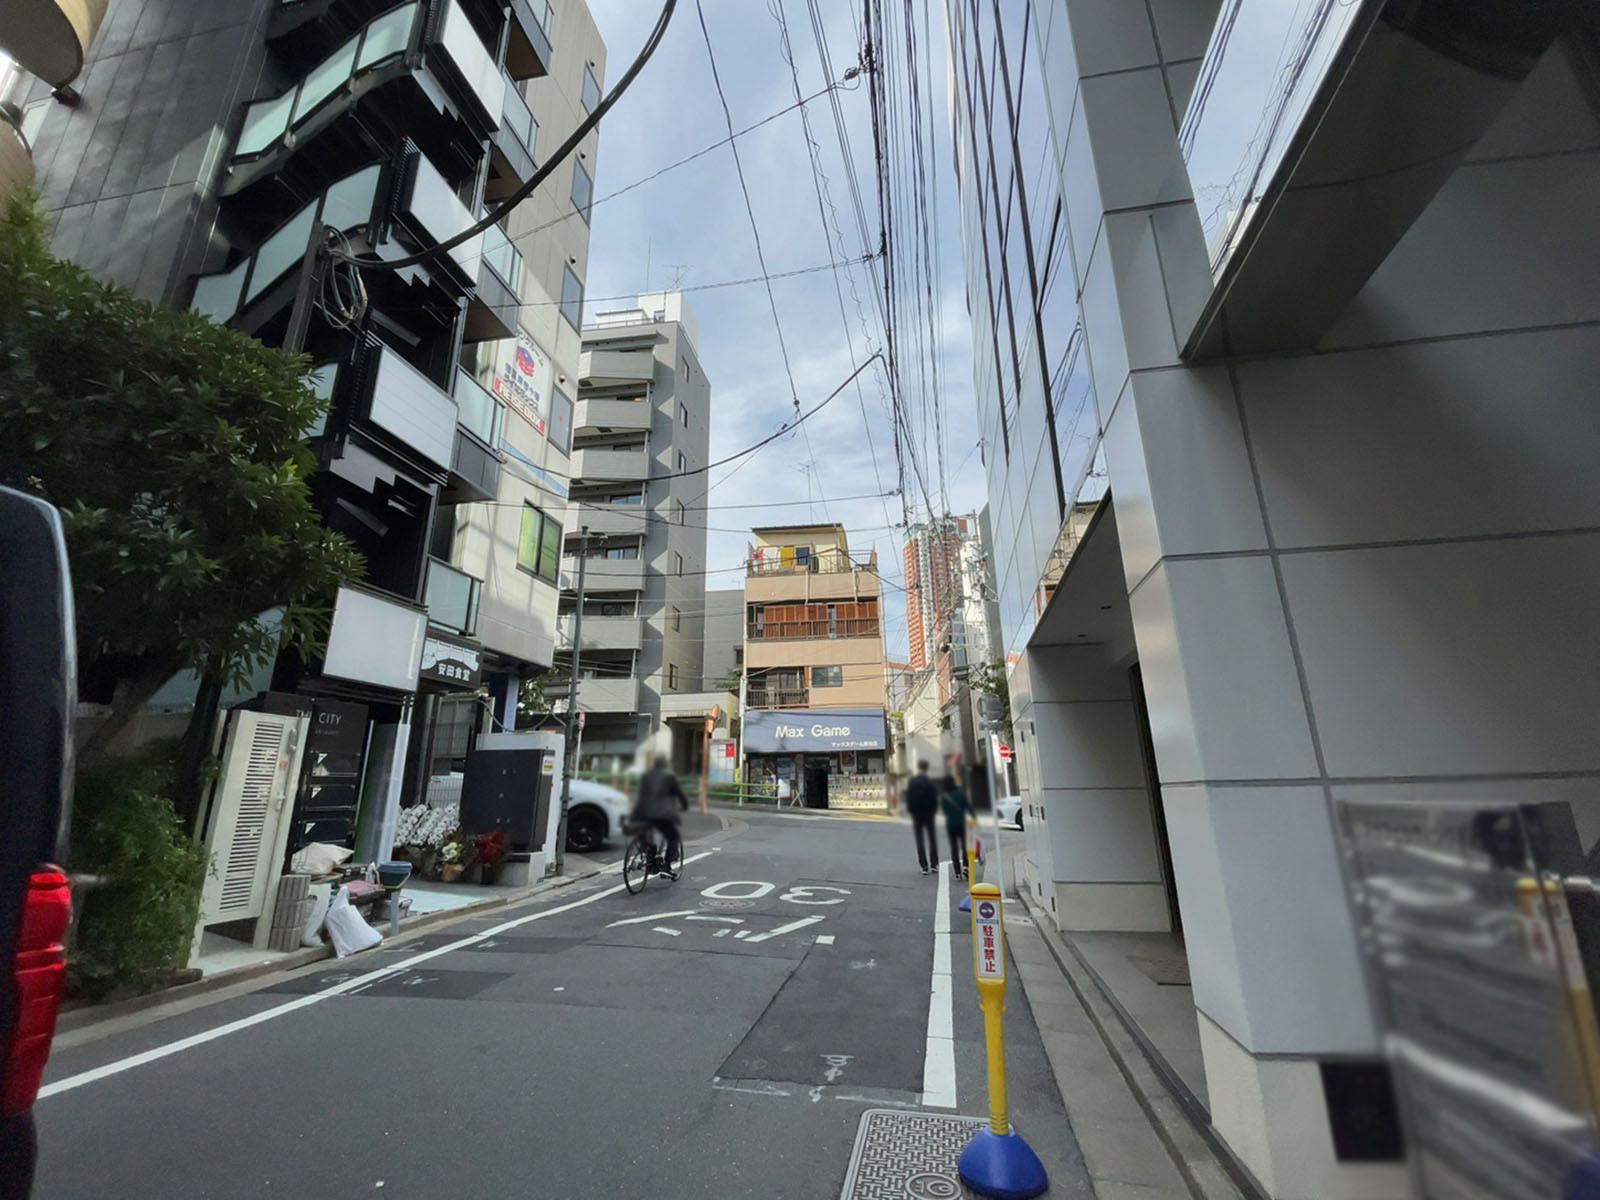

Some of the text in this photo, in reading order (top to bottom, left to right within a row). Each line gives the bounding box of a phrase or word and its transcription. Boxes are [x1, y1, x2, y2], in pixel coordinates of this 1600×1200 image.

[318, 712, 342, 725] CITY
[774, 723, 851, 738] Max Game
[700, 880, 852, 905] 30
[982, 925, 996, 973] 駐車禁止
